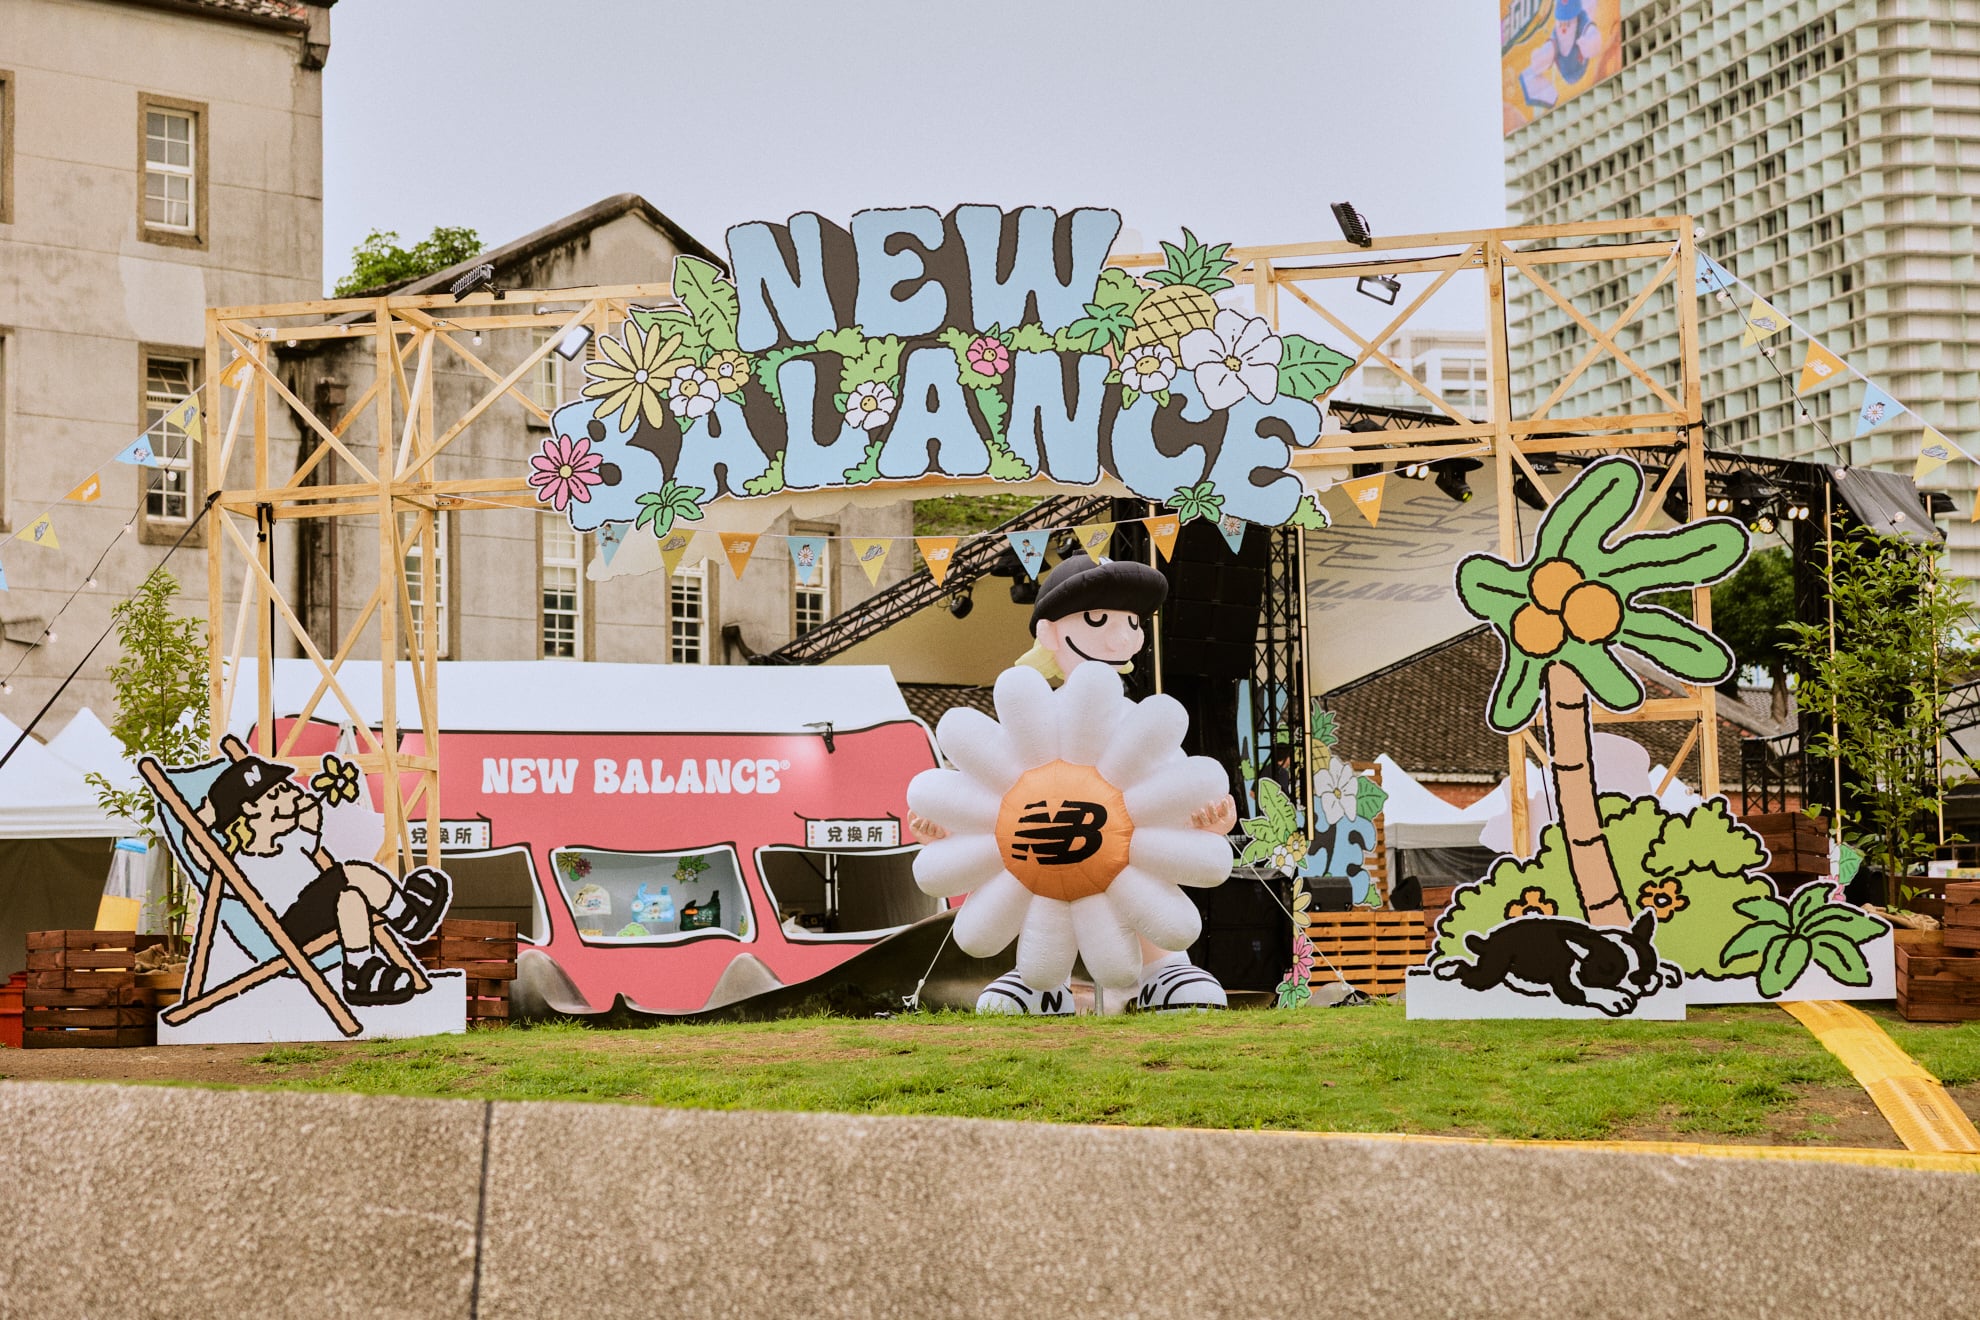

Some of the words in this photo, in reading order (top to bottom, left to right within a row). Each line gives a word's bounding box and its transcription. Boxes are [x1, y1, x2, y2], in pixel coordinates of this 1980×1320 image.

[726, 203, 1121, 351] NEW
[552, 347, 1325, 530] BALANCE
[243, 765, 262, 787] N
[481, 758, 579, 794] NEW
[827, 826, 883, 843] 兌換所
